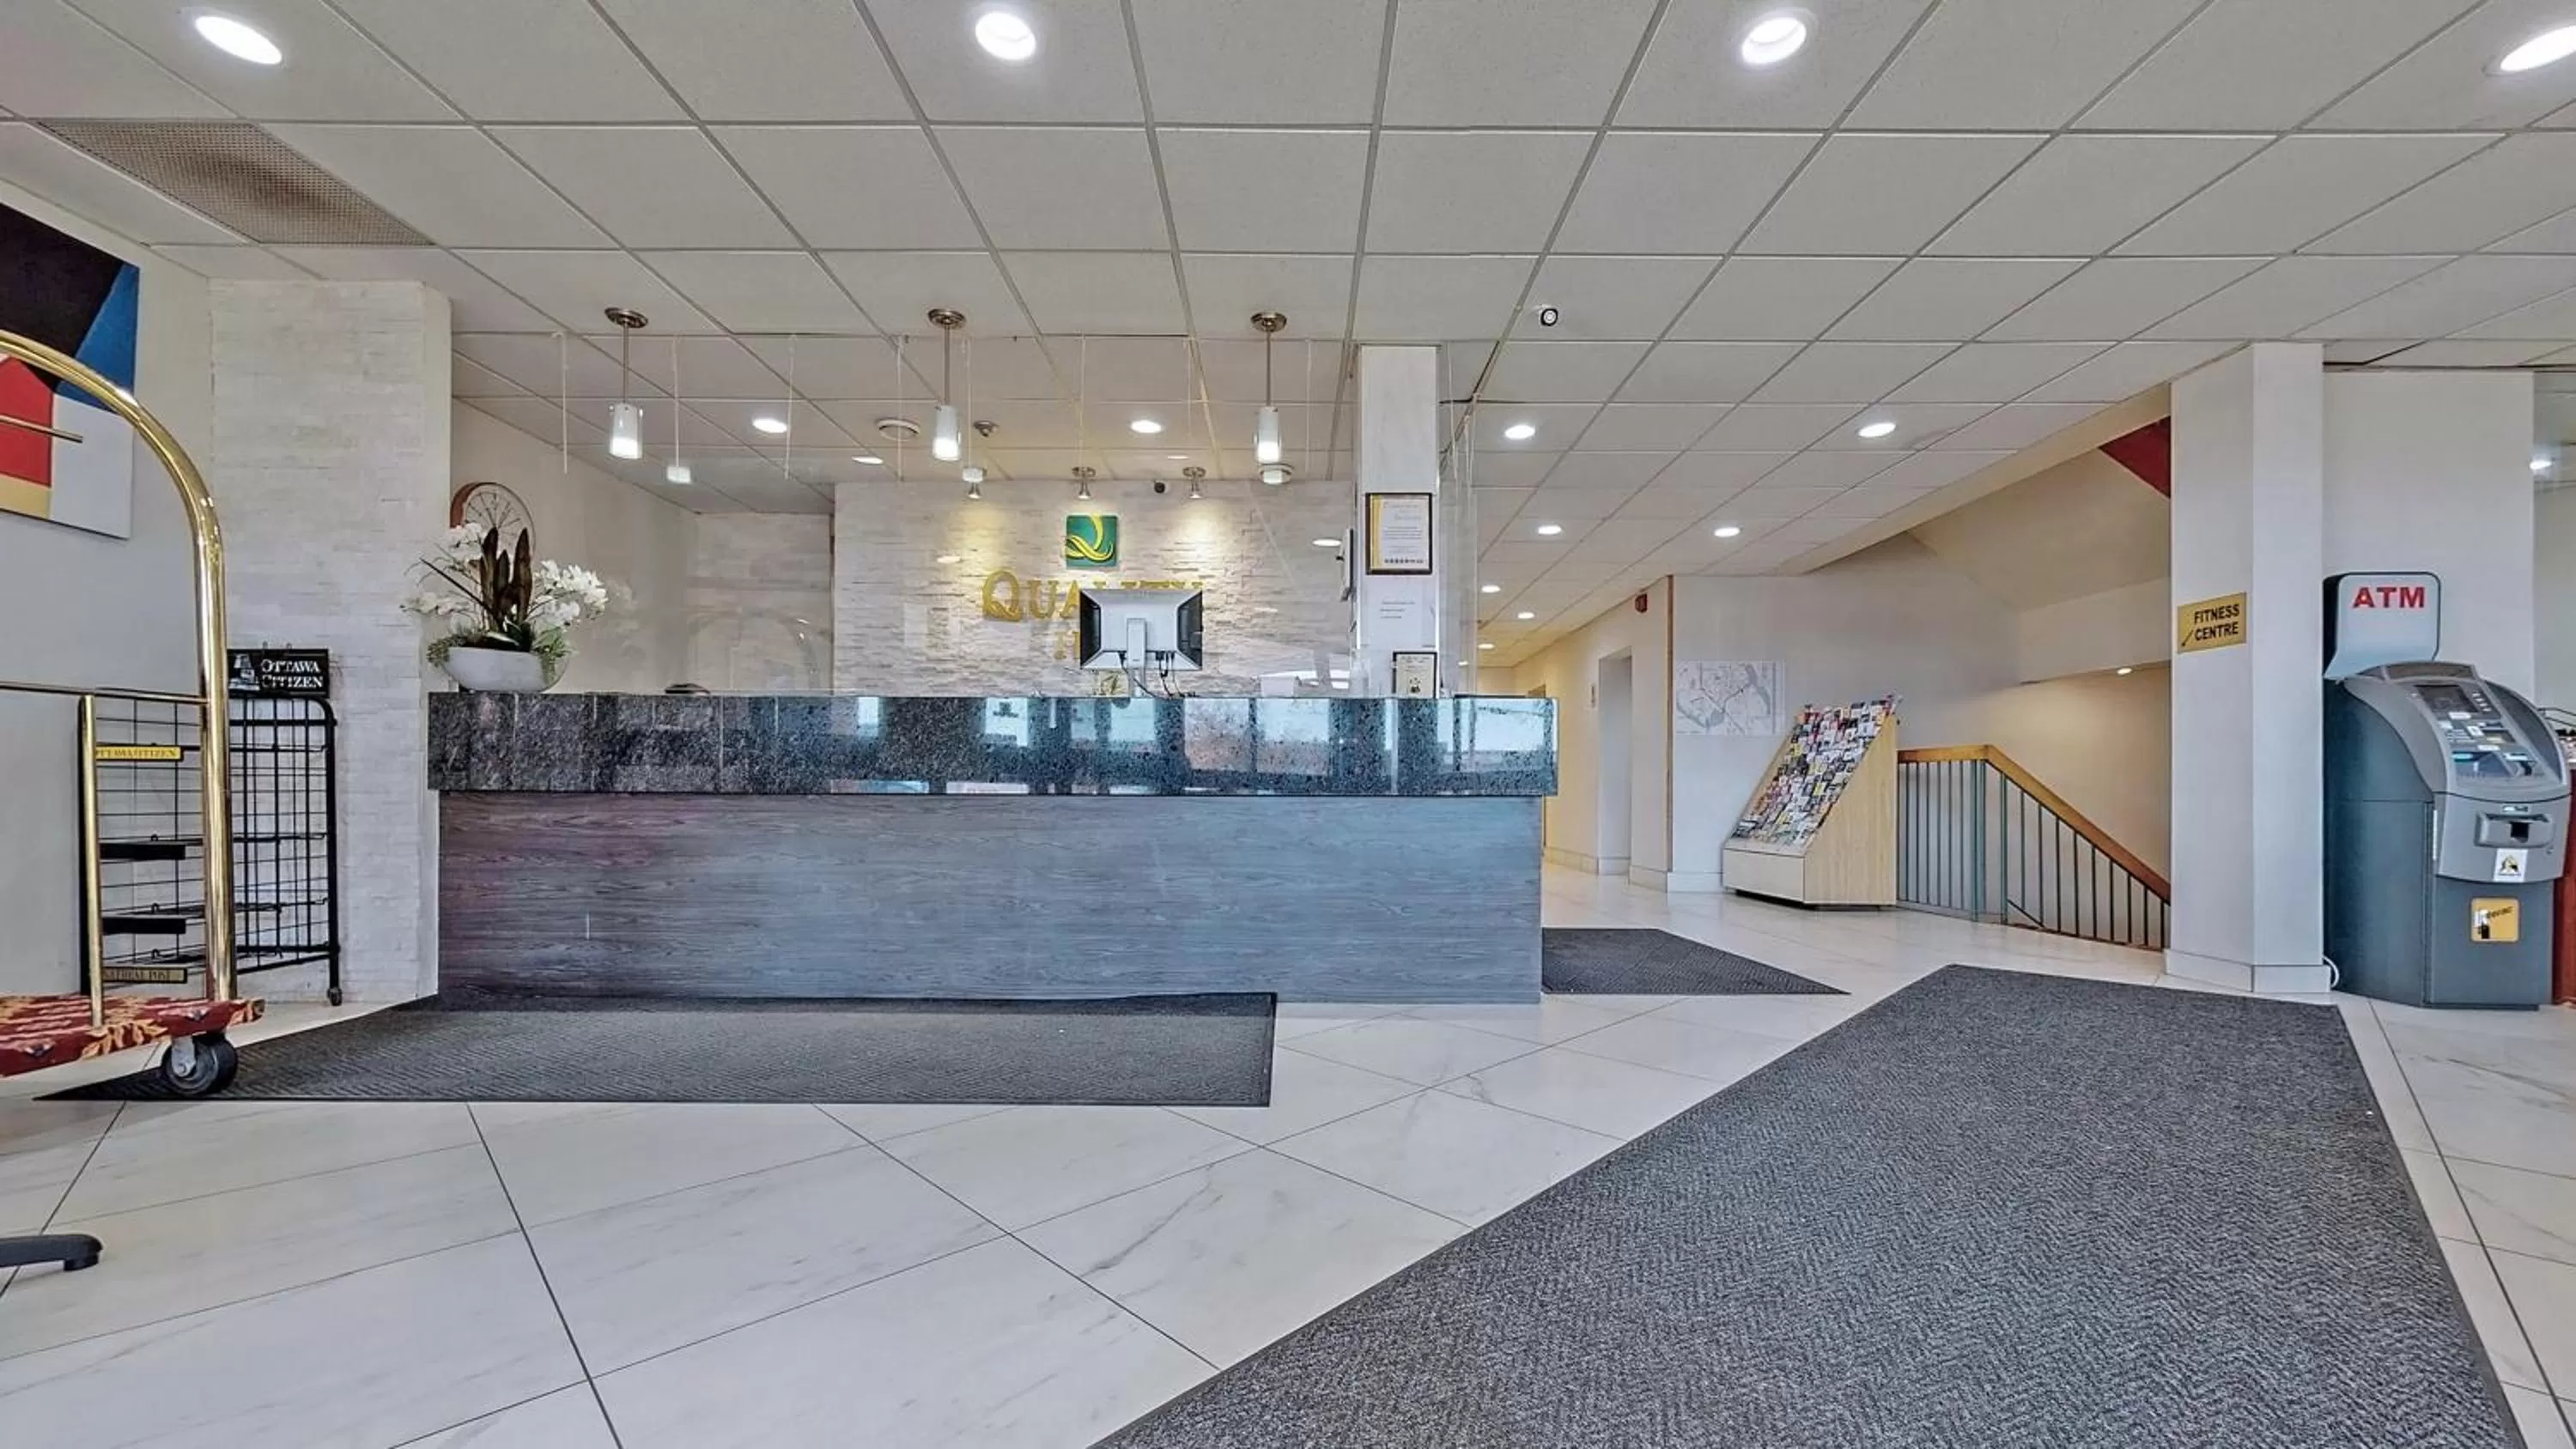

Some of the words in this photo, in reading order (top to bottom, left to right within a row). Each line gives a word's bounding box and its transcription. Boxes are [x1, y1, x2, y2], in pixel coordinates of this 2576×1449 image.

[2353, 586, 2425, 608] ATM
[2194, 603, 2239, 625] FITNESS
[2195, 621, 2239, 640] CENTRE
[260, 658, 320, 673] OTTAWA
[261, 675, 324, 688] CITIZEN
